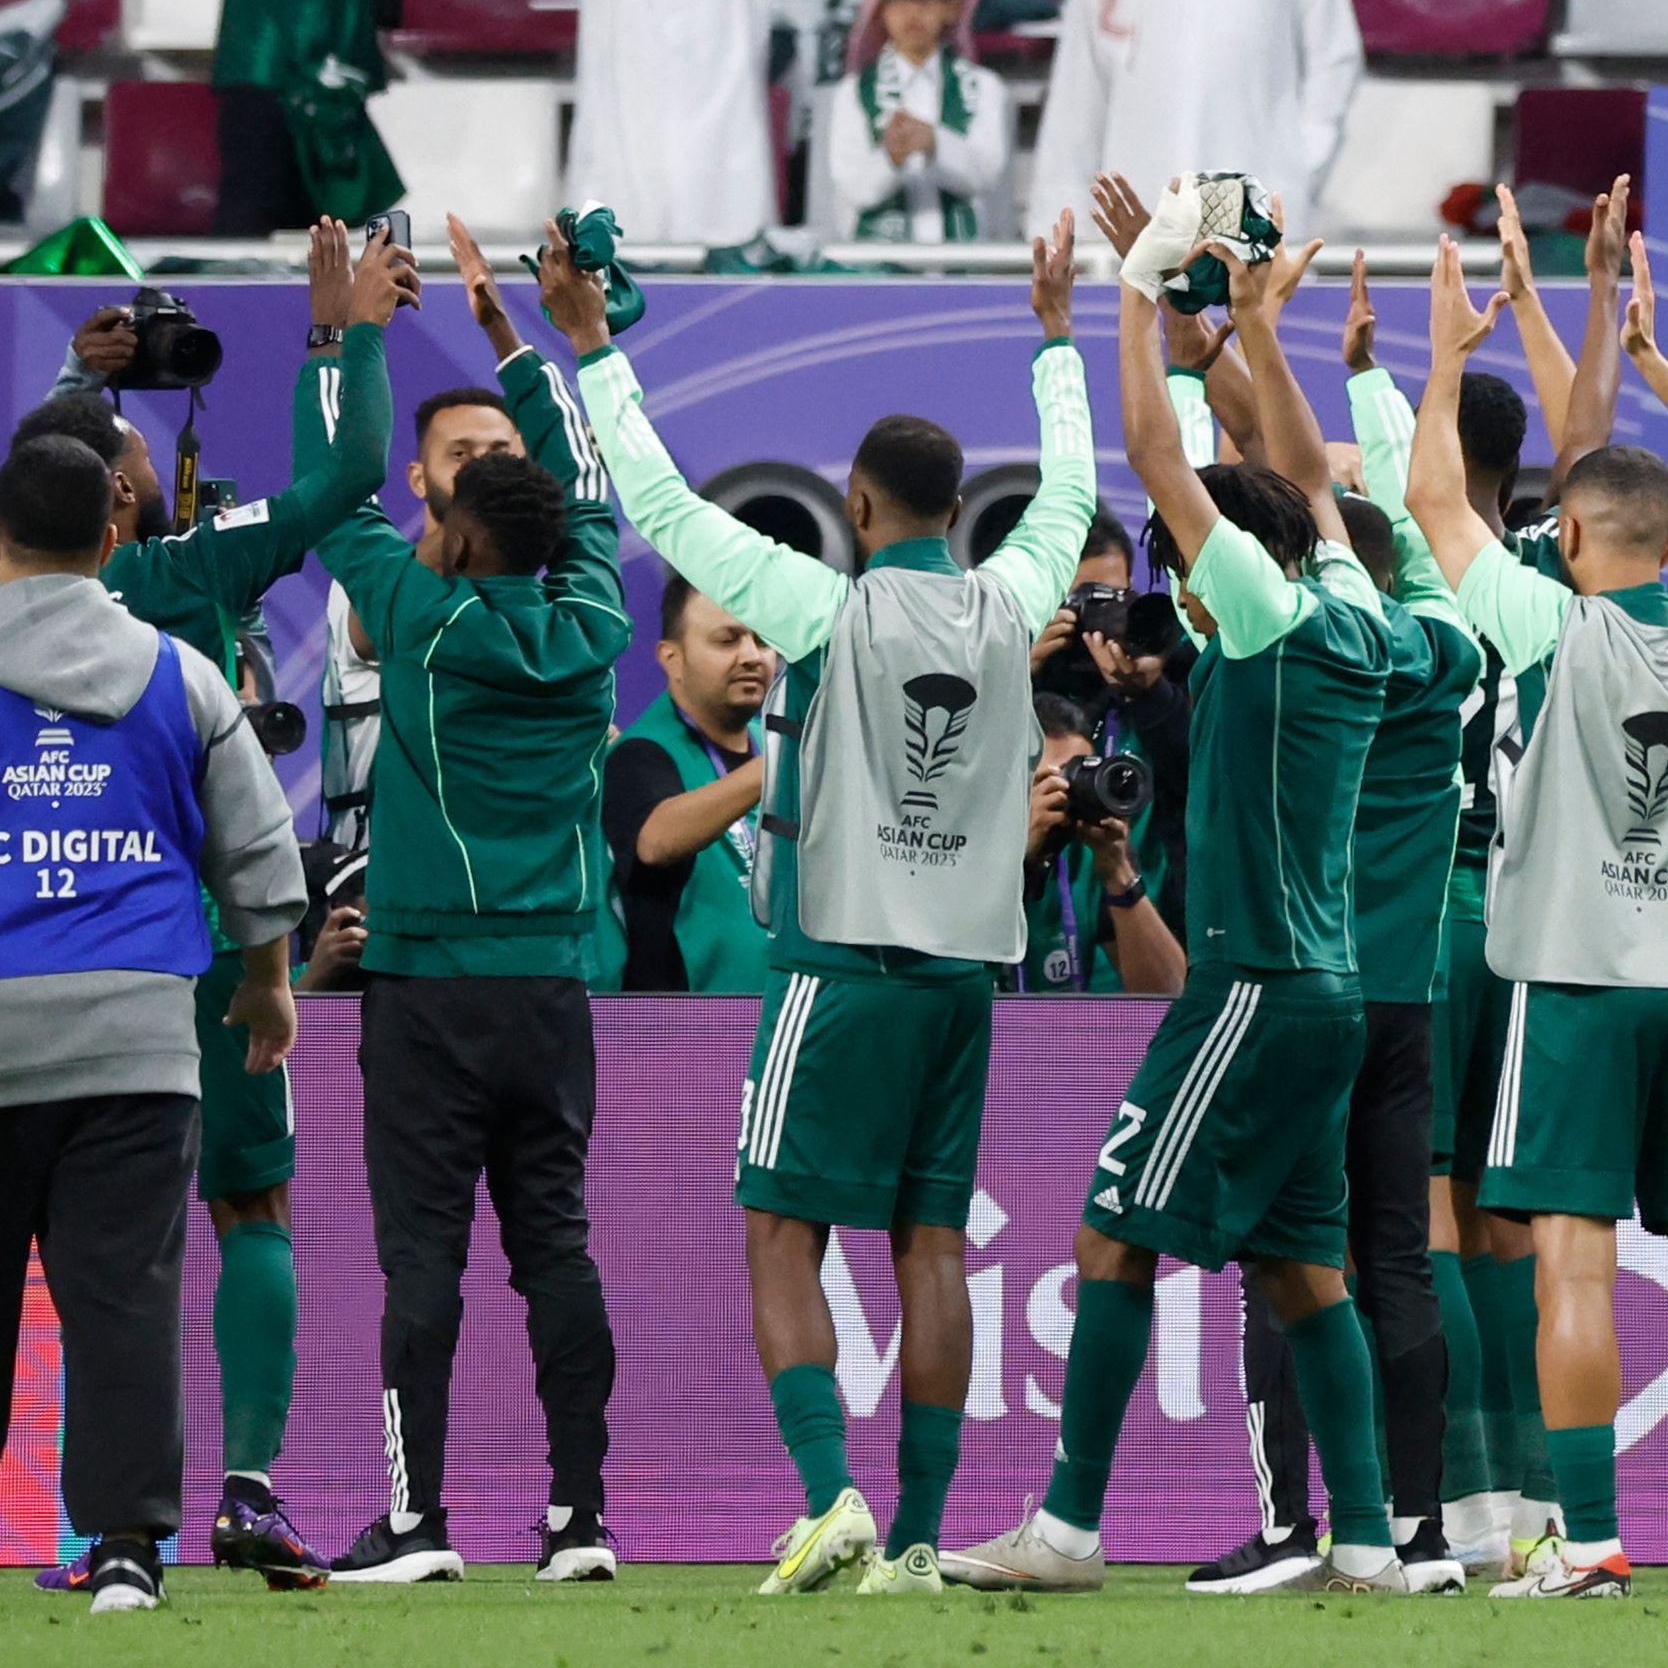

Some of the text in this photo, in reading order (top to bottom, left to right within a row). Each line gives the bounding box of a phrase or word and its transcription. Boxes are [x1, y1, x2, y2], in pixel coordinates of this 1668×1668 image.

[40, 750, 70, 764] AFC
[2, 764, 112, 783] ASIAN CUP
[8, 783, 103, 800] QATAR 2023
[901, 814, 932, 829] AFC
[23, 830, 162, 863] DIGITAL
[926, 833, 967, 851] CUP
[1624, 851, 1656, 865] AFC
[1601, 860, 1650, 885] ASIAN
[36, 868, 77, 898] 12
[1050, 960, 1068, 979] 12
